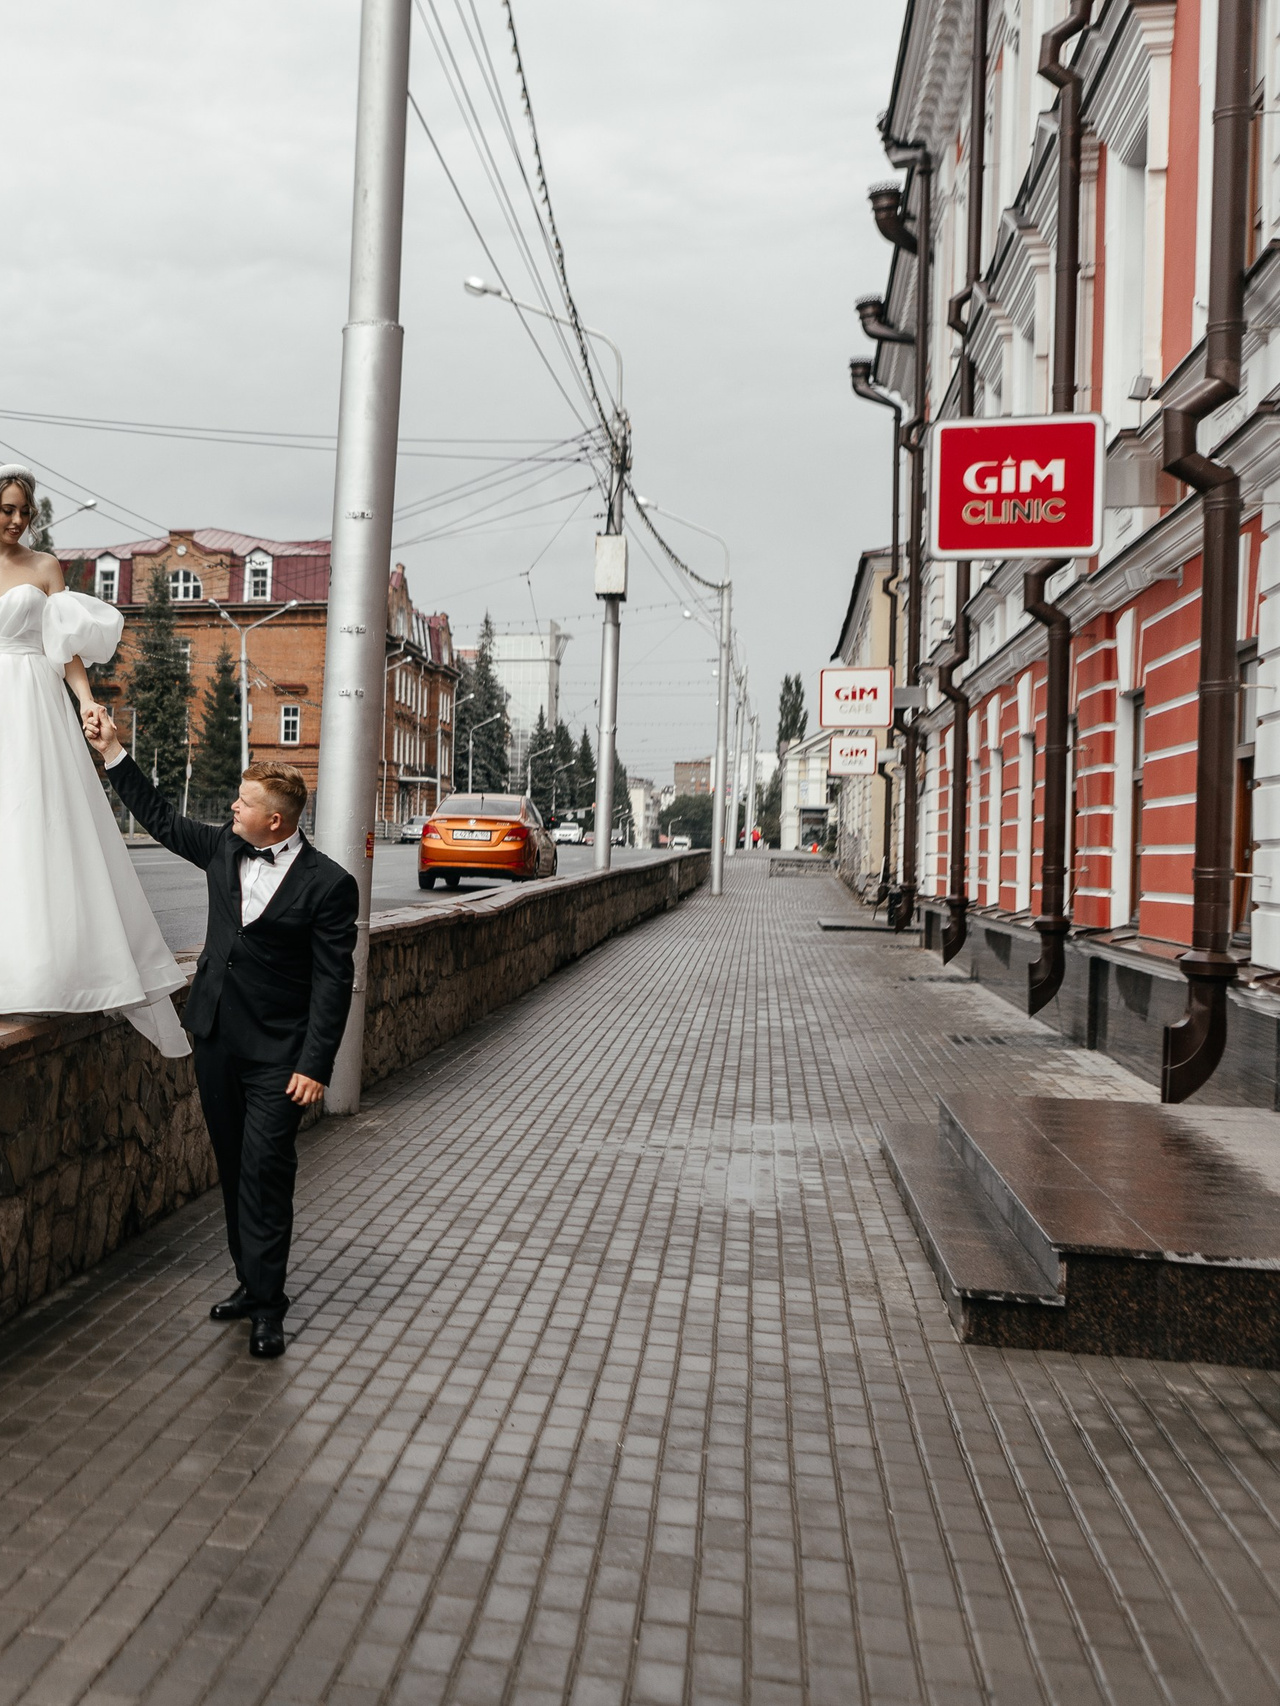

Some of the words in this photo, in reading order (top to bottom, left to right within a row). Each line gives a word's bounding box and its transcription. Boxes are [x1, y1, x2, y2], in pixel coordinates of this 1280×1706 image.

[961, 497, 1067, 525] CLINIC
[839, 704, 873, 715] CAFE
[841, 758, 864, 766] CAFE
